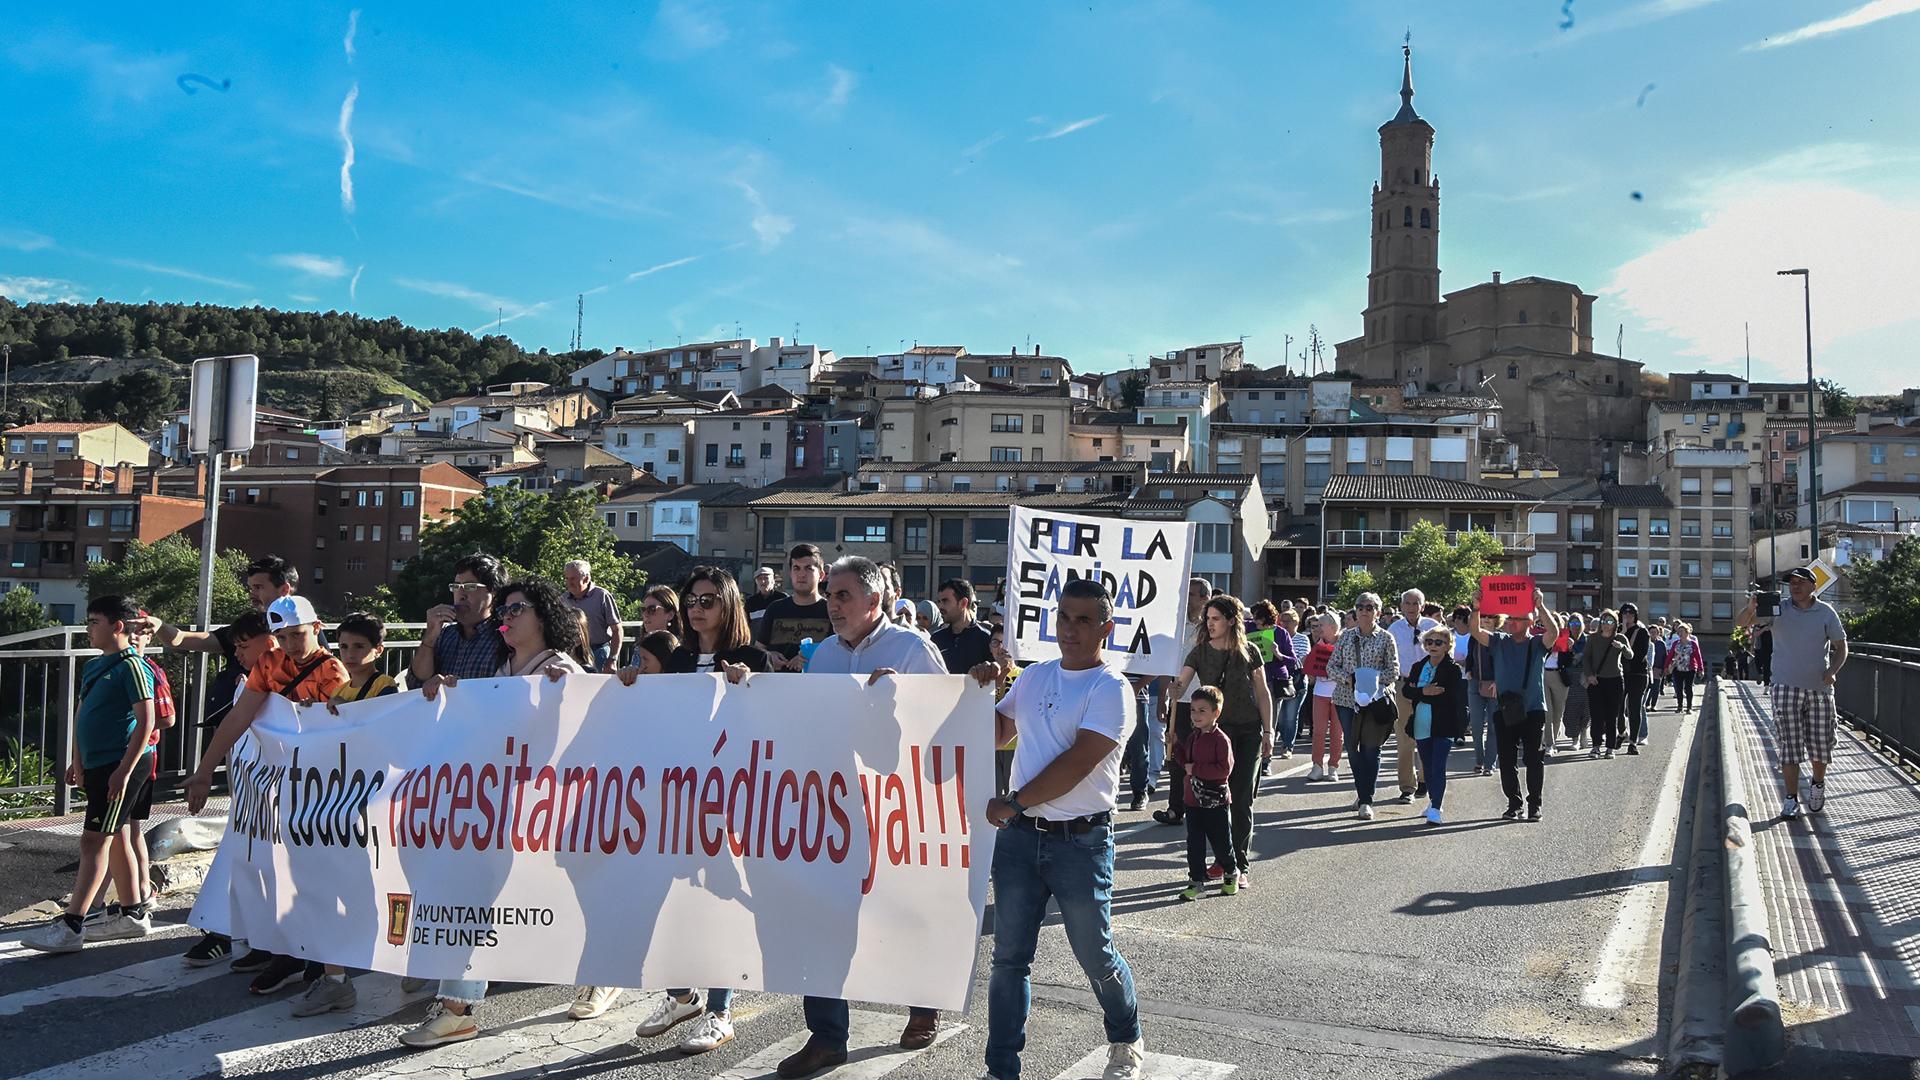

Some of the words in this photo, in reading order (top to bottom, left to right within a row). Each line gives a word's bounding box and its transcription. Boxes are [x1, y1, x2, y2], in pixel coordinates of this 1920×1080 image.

[1029, 517, 1100, 558] POR
[1121, 527, 1173, 560] LA
[1489, 582, 1527, 591] MEDICOS
[1499, 596, 1517, 605] YA!!!
[1016, 603, 1151, 655] PÚCA
[288, 742, 384, 869] todos,
[389, 736, 647, 858] necesitamos
[658, 729, 850, 865] médicos
[861, 745, 971, 895] ya!!!
[415, 904, 554, 926] AYUNTAMIENTO
[413, 926, 430, 945] DE
[435, 928, 499, 947] FUNES
